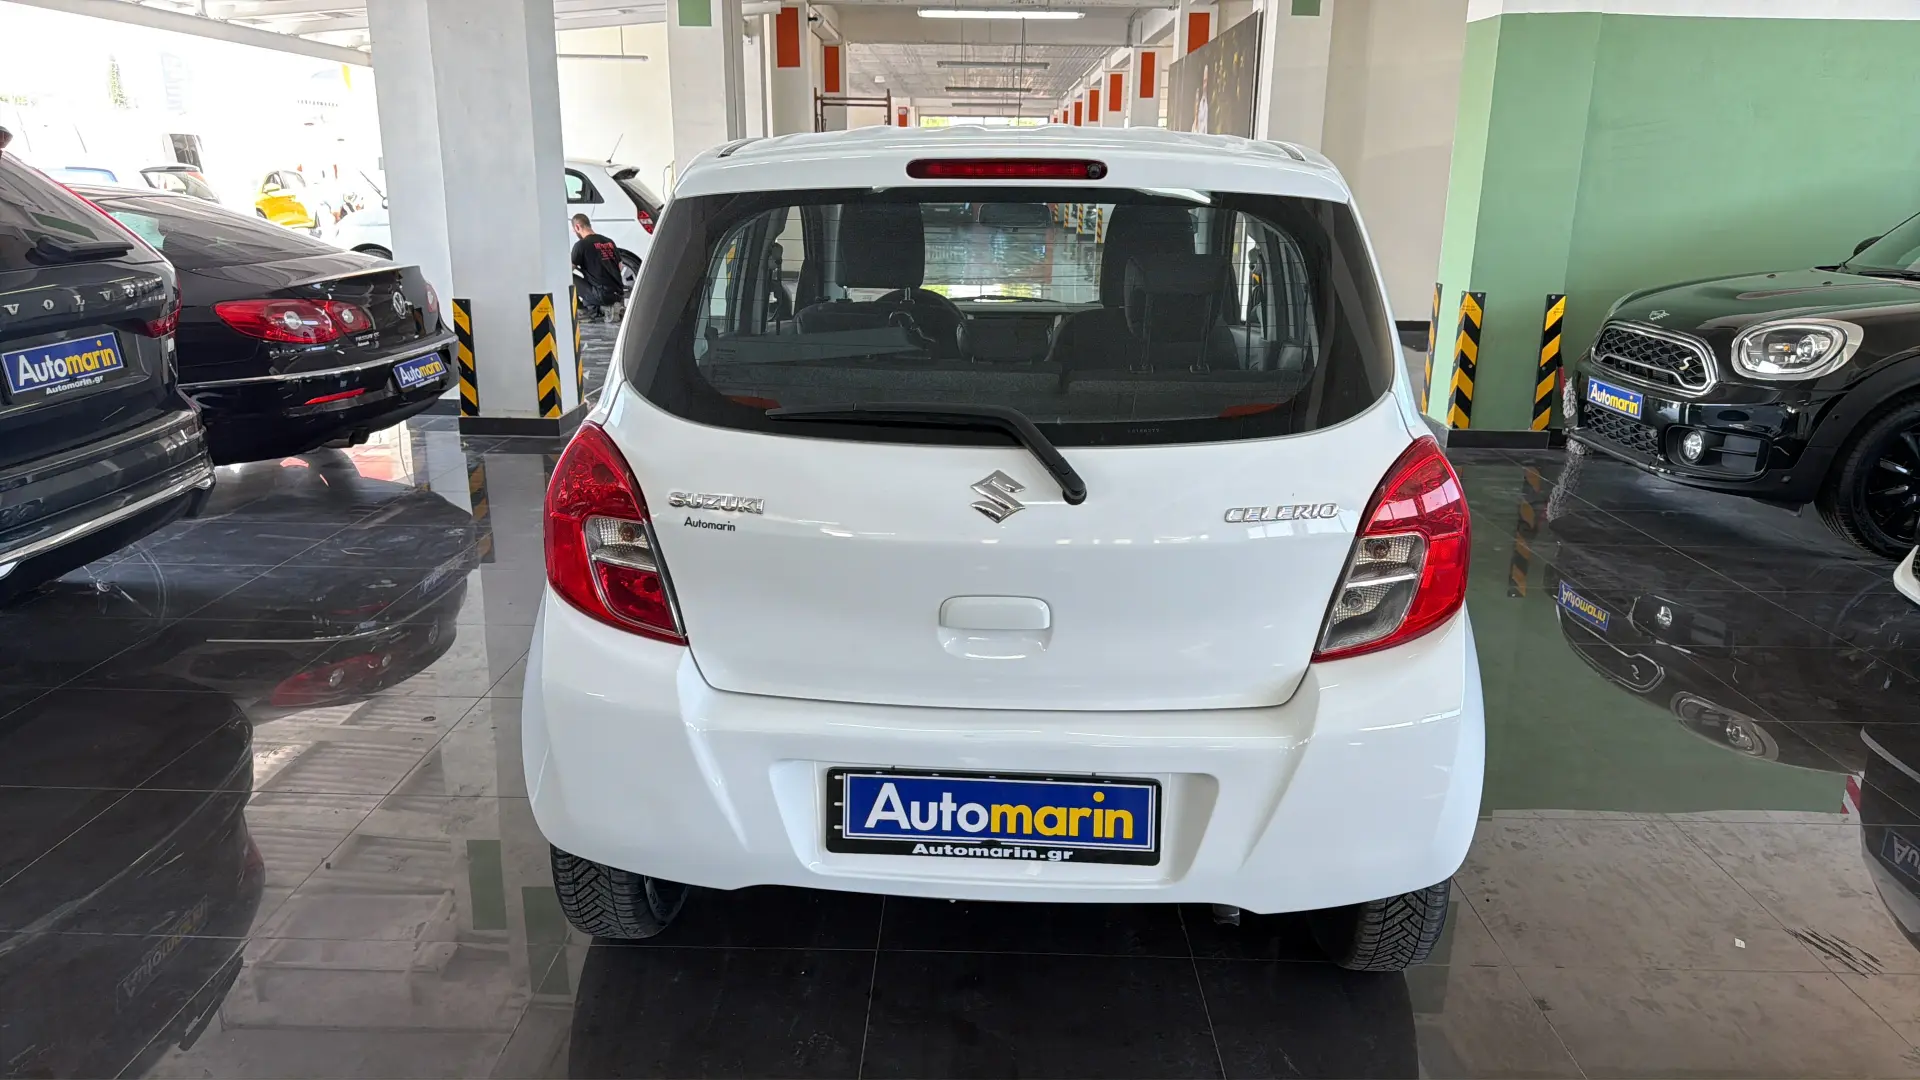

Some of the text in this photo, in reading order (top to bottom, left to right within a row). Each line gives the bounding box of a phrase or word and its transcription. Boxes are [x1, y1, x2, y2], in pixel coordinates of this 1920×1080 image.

[3, 287, 136, 315] VOLVO
[19, 340, 117, 387] Automarin
[399, 357, 442, 384] Automarin
[45, 375, 104, 395] Automarin.gr
[1590, 382, 1638, 415] Automarin
[668, 491, 765, 515] SUZUKI
[1224, 502, 1340, 523] CELERIO
[684, 516, 736, 532] Automarin
[864, 782, 1134, 840] Automarin
[912, 843, 1074, 862] Automarin.gr
